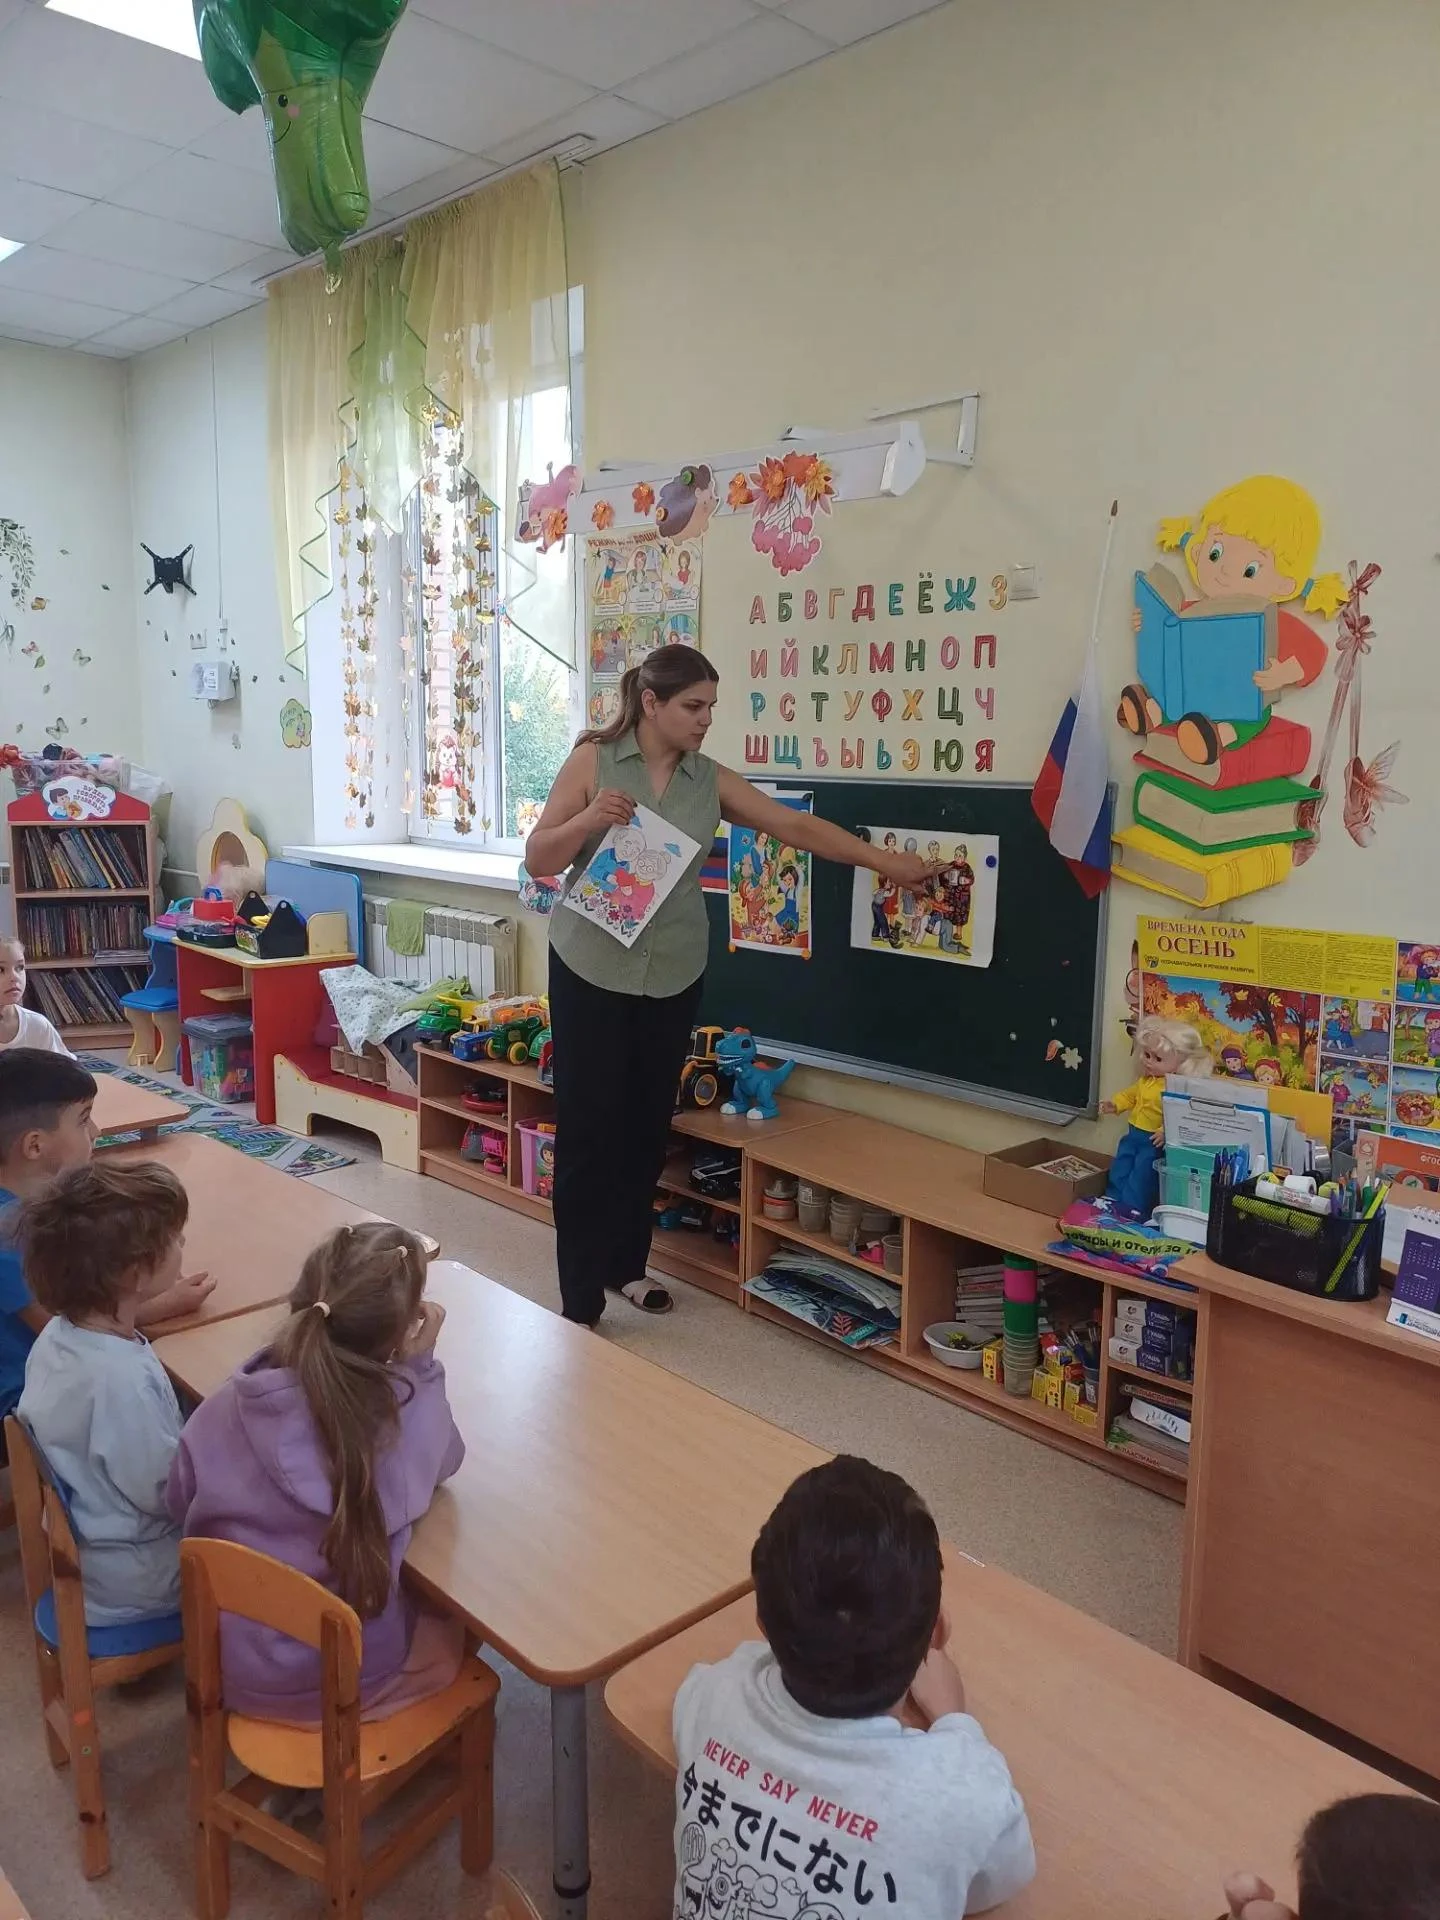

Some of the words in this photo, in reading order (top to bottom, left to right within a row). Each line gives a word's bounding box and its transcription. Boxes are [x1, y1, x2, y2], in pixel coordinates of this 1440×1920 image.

[750, 595, 766, 624] А
[778, 592, 792, 622] Б
[804, 589, 818, 619] В
[828, 588, 844, 619] Г
[852, 584, 875, 622] Д
[889, 583, 904, 615] Е
[918, 572, 933, 614] Ё
[944, 576, 976, 612] Ж
[989, 574, 1008, 610] З
[750, 649, 767, 678] И
[780, 638, 799, 678] Й
[812, 645, 829, 675] К
[837, 643, 858, 674] Л
[870, 641, 894, 673] М
[906, 639, 926, 671] Н
[940, 636, 960, 670] О
[974, 635, 996, 668] П
[750, 692, 766, 721] Р
[780, 692, 795, 721] С
[811, 692, 829, 721] Т
[844, 690, 864, 721] У
[872, 688, 892, 722] Ф
[902, 688, 924, 720] Х
[938, 687, 963, 725] Ц
[974, 687, 994, 720] Ч
[745, 734, 768, 764] Ш
[774, 735, 802, 769] Щ
[813, 737, 829, 767] Ъ
[840, 738, 864, 768] Ы
[877, 738, 892, 770] Ь
[902, 738, 920, 771] Э
[934, 739, 963, 772] Ю
[975, 739, 995, 772] Я
[1147, 920, 1206, 935] ВРЕМЕНА
[1212, 926, 1246, 938] ГОДА
[1158, 935, 1235, 958] ОСЕНЬ
[703, 1737, 750, 1780] NEVER
[759, 1772, 799, 1804] SAY
[806, 1796, 878, 1842] NEVER
[682, 1761, 897, 1905] 今までにない
